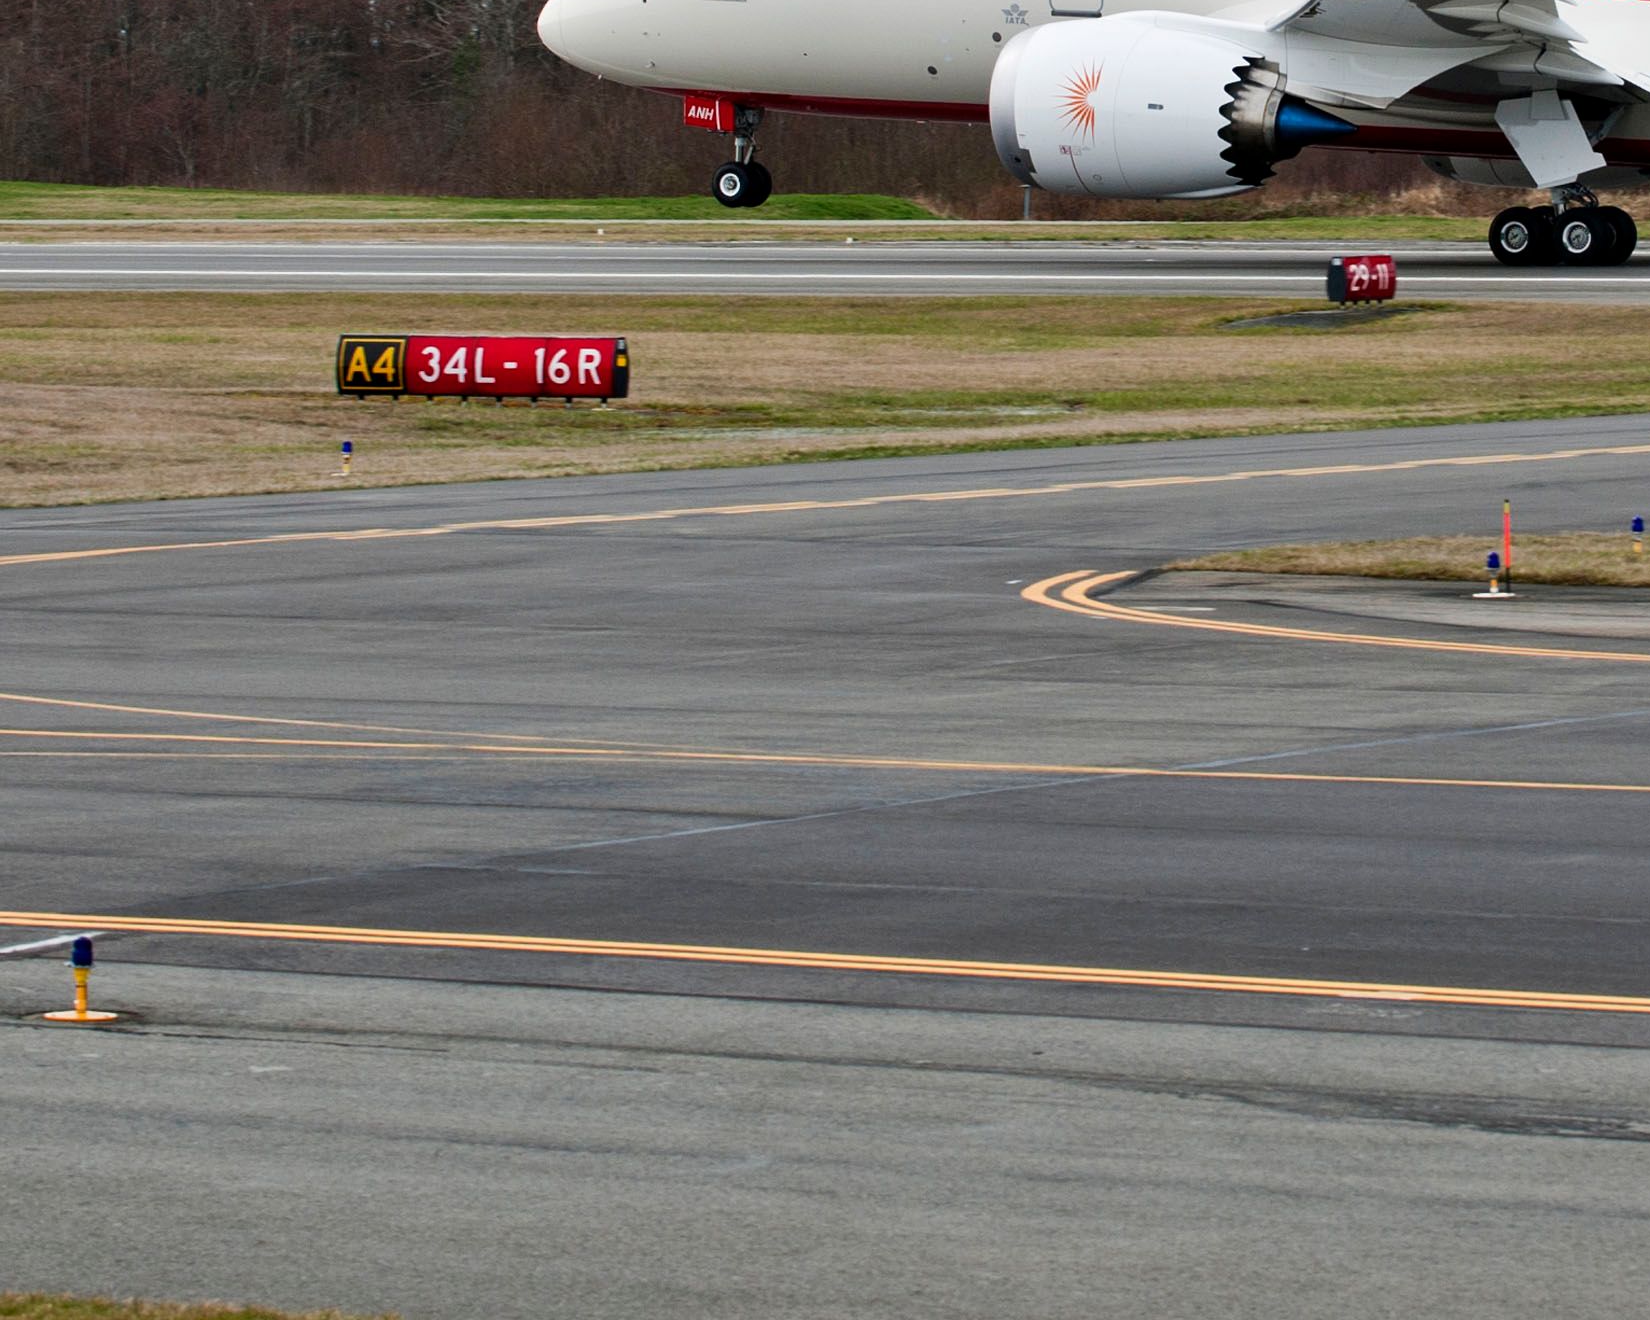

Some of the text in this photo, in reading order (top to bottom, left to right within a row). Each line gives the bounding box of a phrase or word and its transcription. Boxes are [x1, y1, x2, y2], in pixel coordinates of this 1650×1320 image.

[1005, 16, 1026, 25] IATA
[687, 105, 714, 121] ANH
[1349, 263, 1389, 291] 29-11
[346, 346, 396, 382] A4
